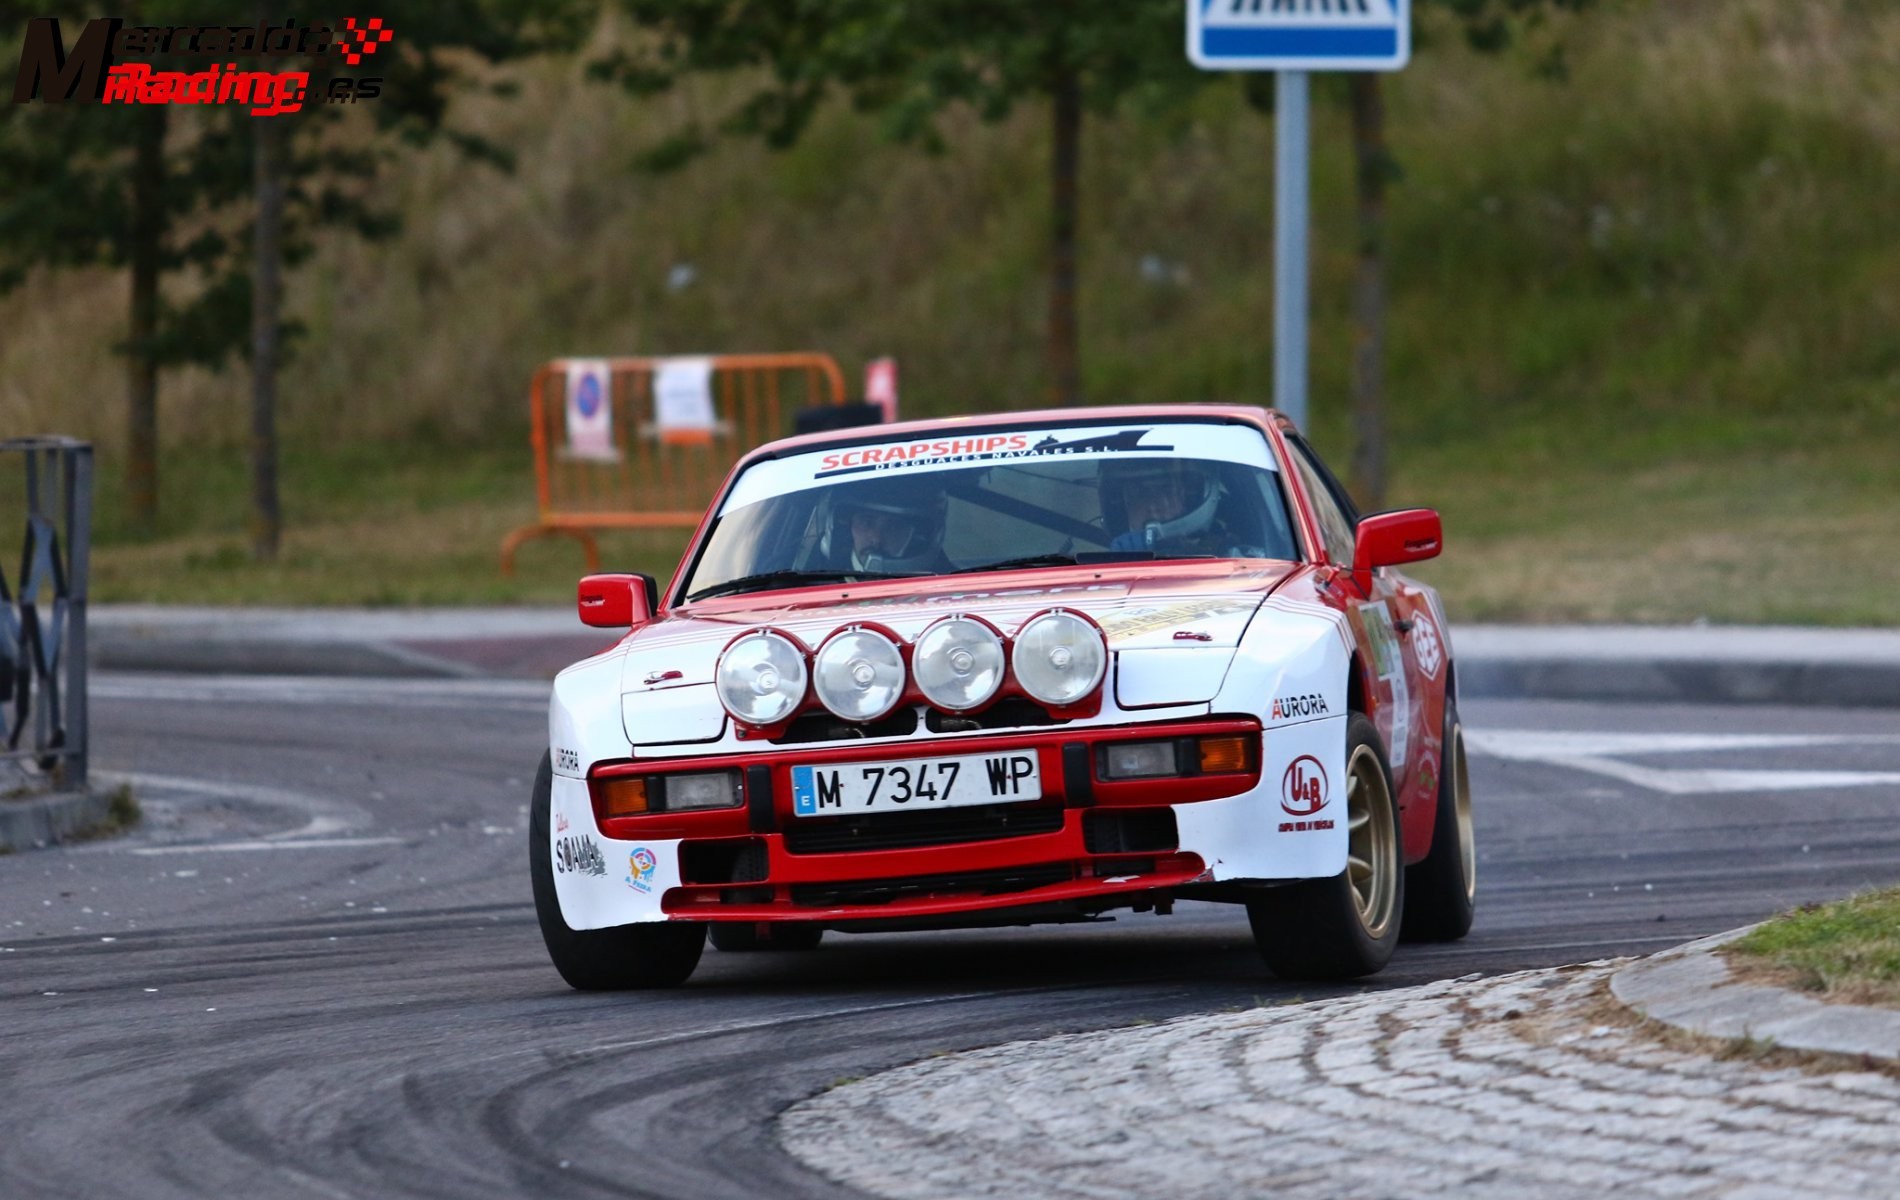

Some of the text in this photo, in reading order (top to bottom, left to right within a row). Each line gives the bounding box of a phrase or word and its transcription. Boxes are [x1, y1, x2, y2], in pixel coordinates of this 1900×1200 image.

[820, 434, 1028, 470] SCRAPSHIPS
[875, 453, 982, 470] DESGUACES
[992, 447, 1074, 459] NAVALES
[1272, 693, 1329, 720] AURORA
[801, 756, 1034, 808] E M 7347 WP
